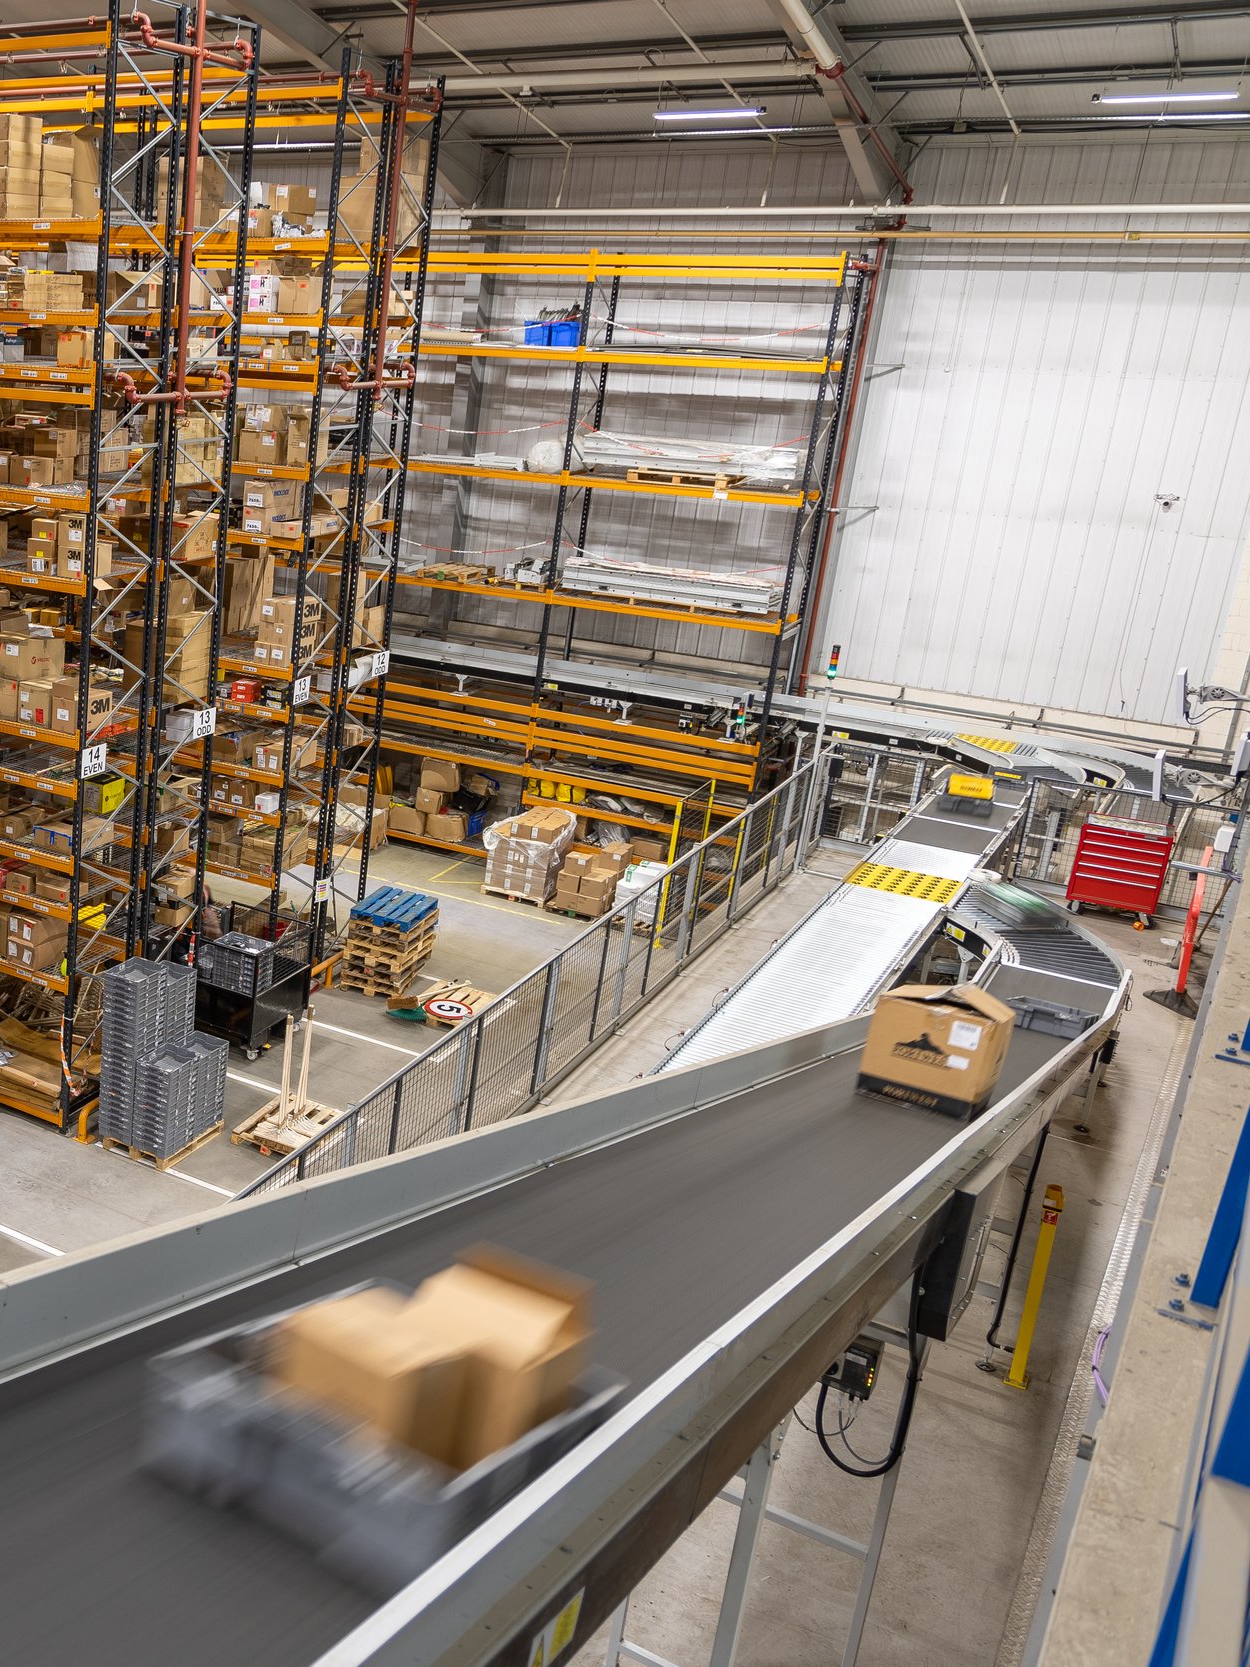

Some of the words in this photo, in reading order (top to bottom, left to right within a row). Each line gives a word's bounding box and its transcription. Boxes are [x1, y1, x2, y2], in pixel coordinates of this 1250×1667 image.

[68, 519, 83, 530] 3M
[67, 550, 81, 561] 3M
[303, 602, 320, 618] 3M
[300, 623, 316, 639] 3M
[299, 644, 313, 659] 3M
[377, 653, 386, 666] 12
[374, 665, 386, 675] ODD
[298, 678, 307, 692] 13
[294, 691, 308, 703] EVEN
[90, 697, 111, 716] 3M
[199, 710, 211, 725] 13
[196, 725, 212, 737] ODD
[88, 746, 100, 763] 14
[83, 761, 103, 776] EVEN
[437, 1004, 462, 1014] 5
